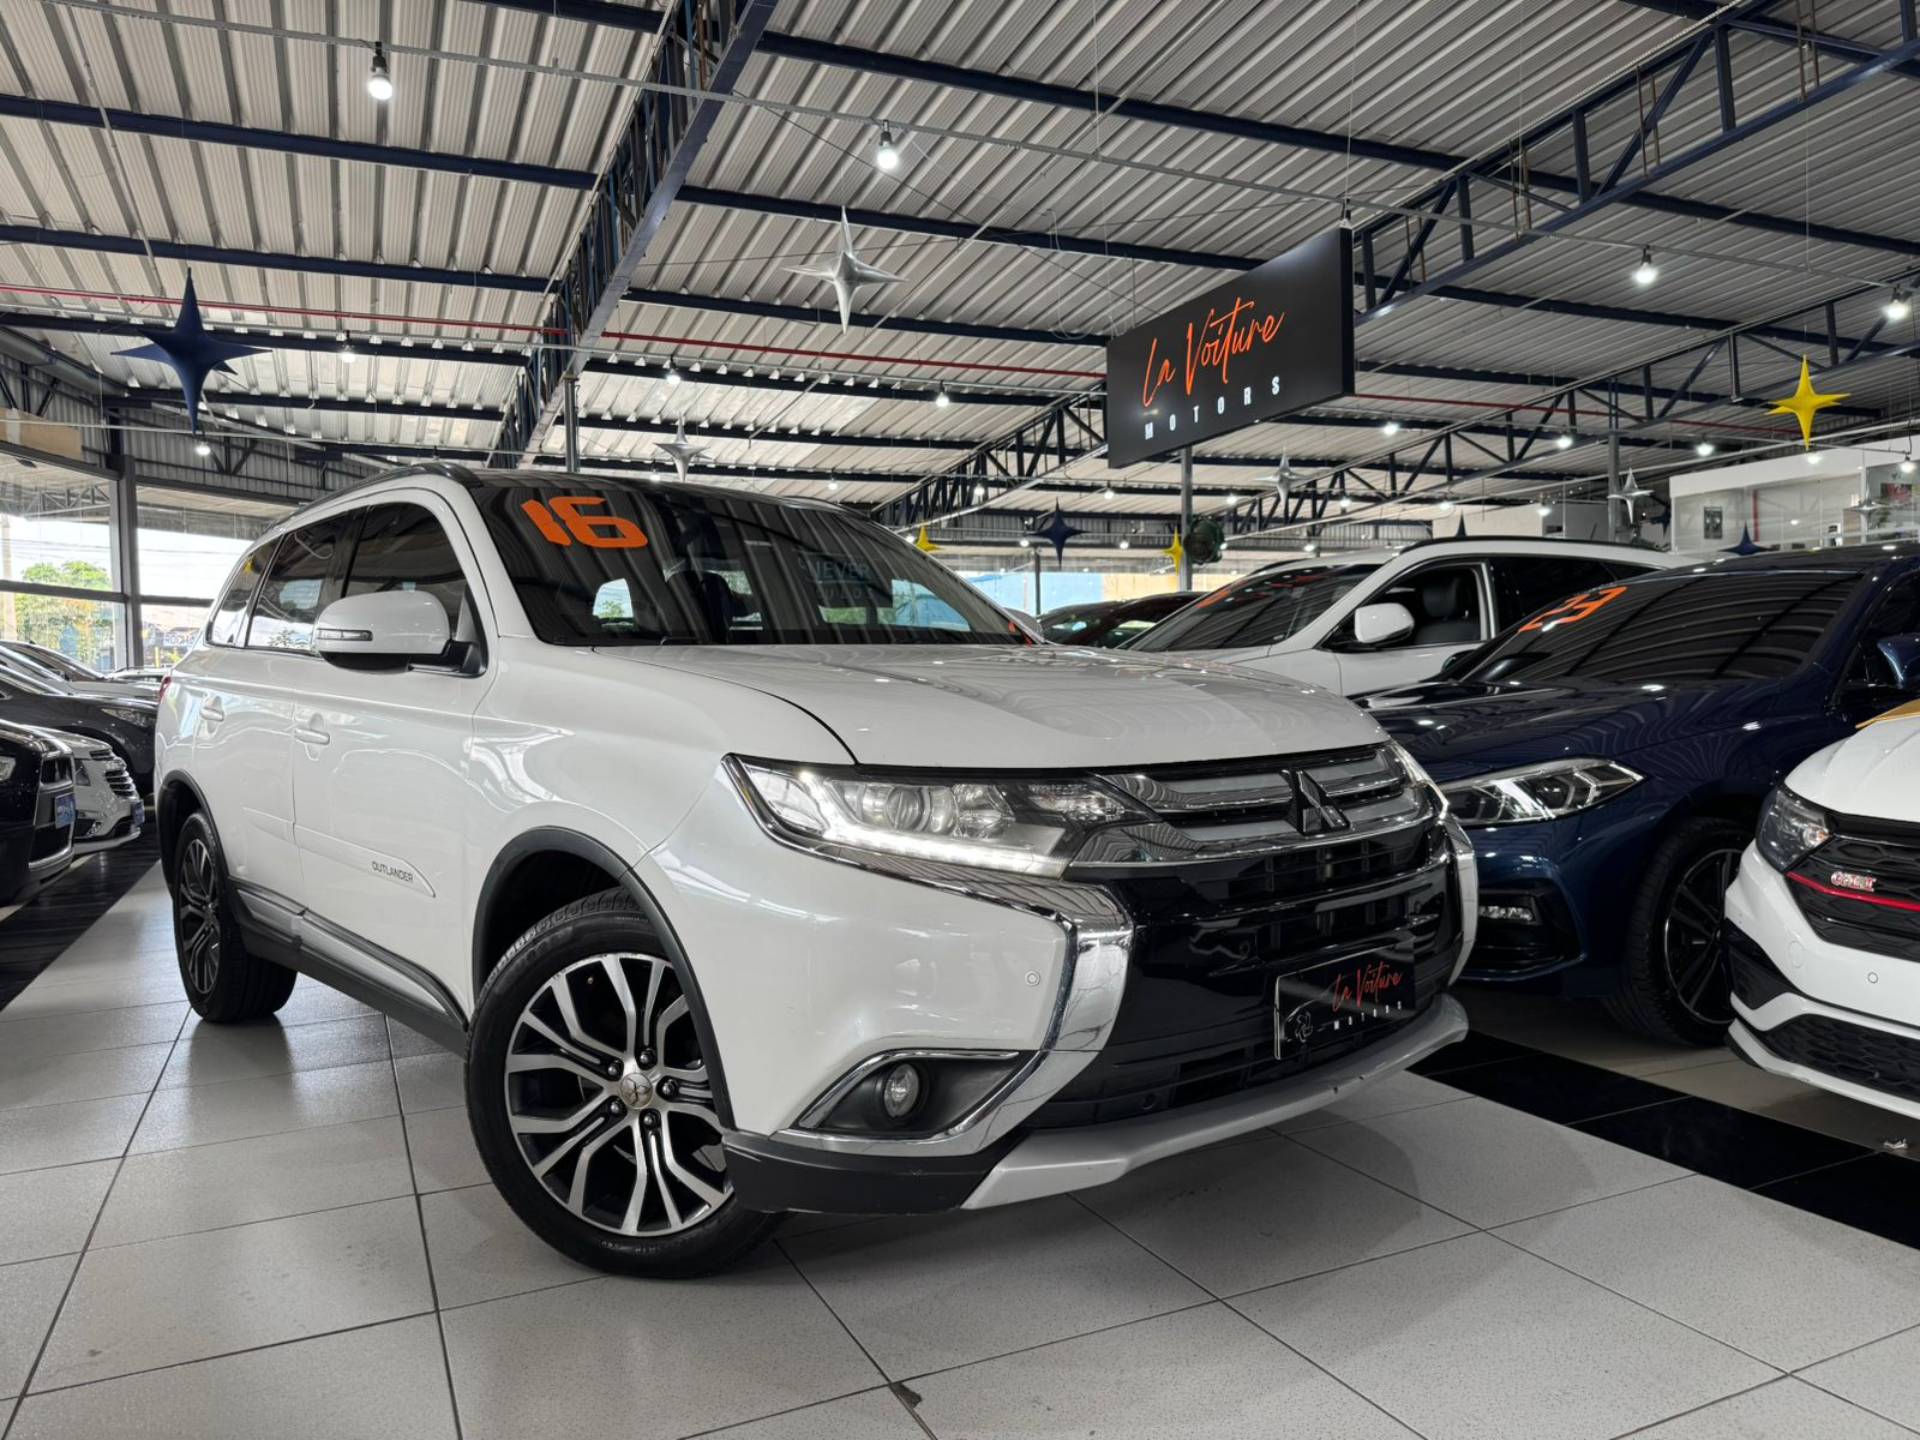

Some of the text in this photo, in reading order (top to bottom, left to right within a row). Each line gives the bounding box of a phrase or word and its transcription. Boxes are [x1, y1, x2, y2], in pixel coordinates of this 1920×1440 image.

[1142, 297, 1285, 408] La Voiture
[1144, 376, 1280, 440] MOTORS
[520, 496, 649, 547] 16
